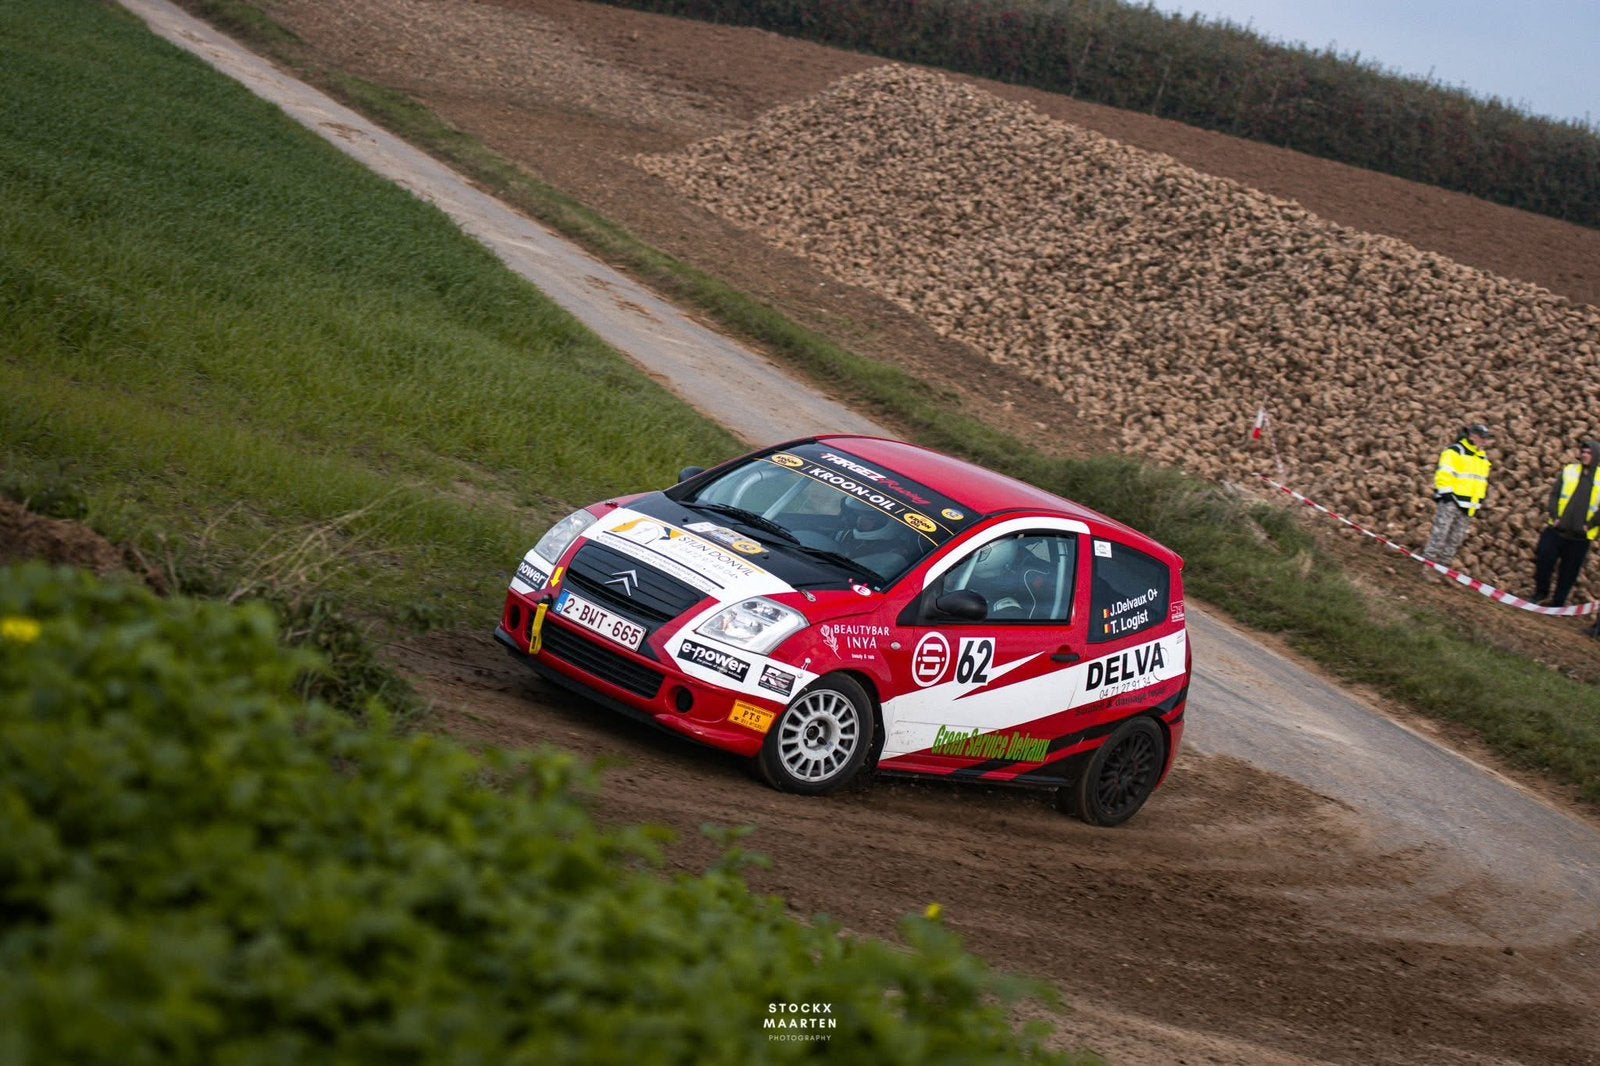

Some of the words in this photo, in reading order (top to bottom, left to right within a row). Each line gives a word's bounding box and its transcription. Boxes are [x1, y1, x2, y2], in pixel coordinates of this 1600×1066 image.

[809, 468, 895, 510] KROON-OIL
[908, 515, 931, 529] KROON
[708, 551, 754, 576] DONVIL
[556, 602, 562, 611] B
[1110, 594, 1147, 617] J.Delvaux
[833, 624, 890, 636] BEAUTYBAR
[1110, 620, 1119, 634] T.
[1121, 609, 1149, 630] Logist
[847, 636, 877, 649] INYA
[681, 642, 746, 673] e-power
[956, 640, 992, 684] 62
[1085, 642, 1165, 691] DELVA
[1100, 689, 1109, 699] 04
[1122, 682, 1130, 693] 27
[742, 710, 761, 723] PTS
[932, 724, 968, 755] Green
[965, 728, 1009, 759] Service
